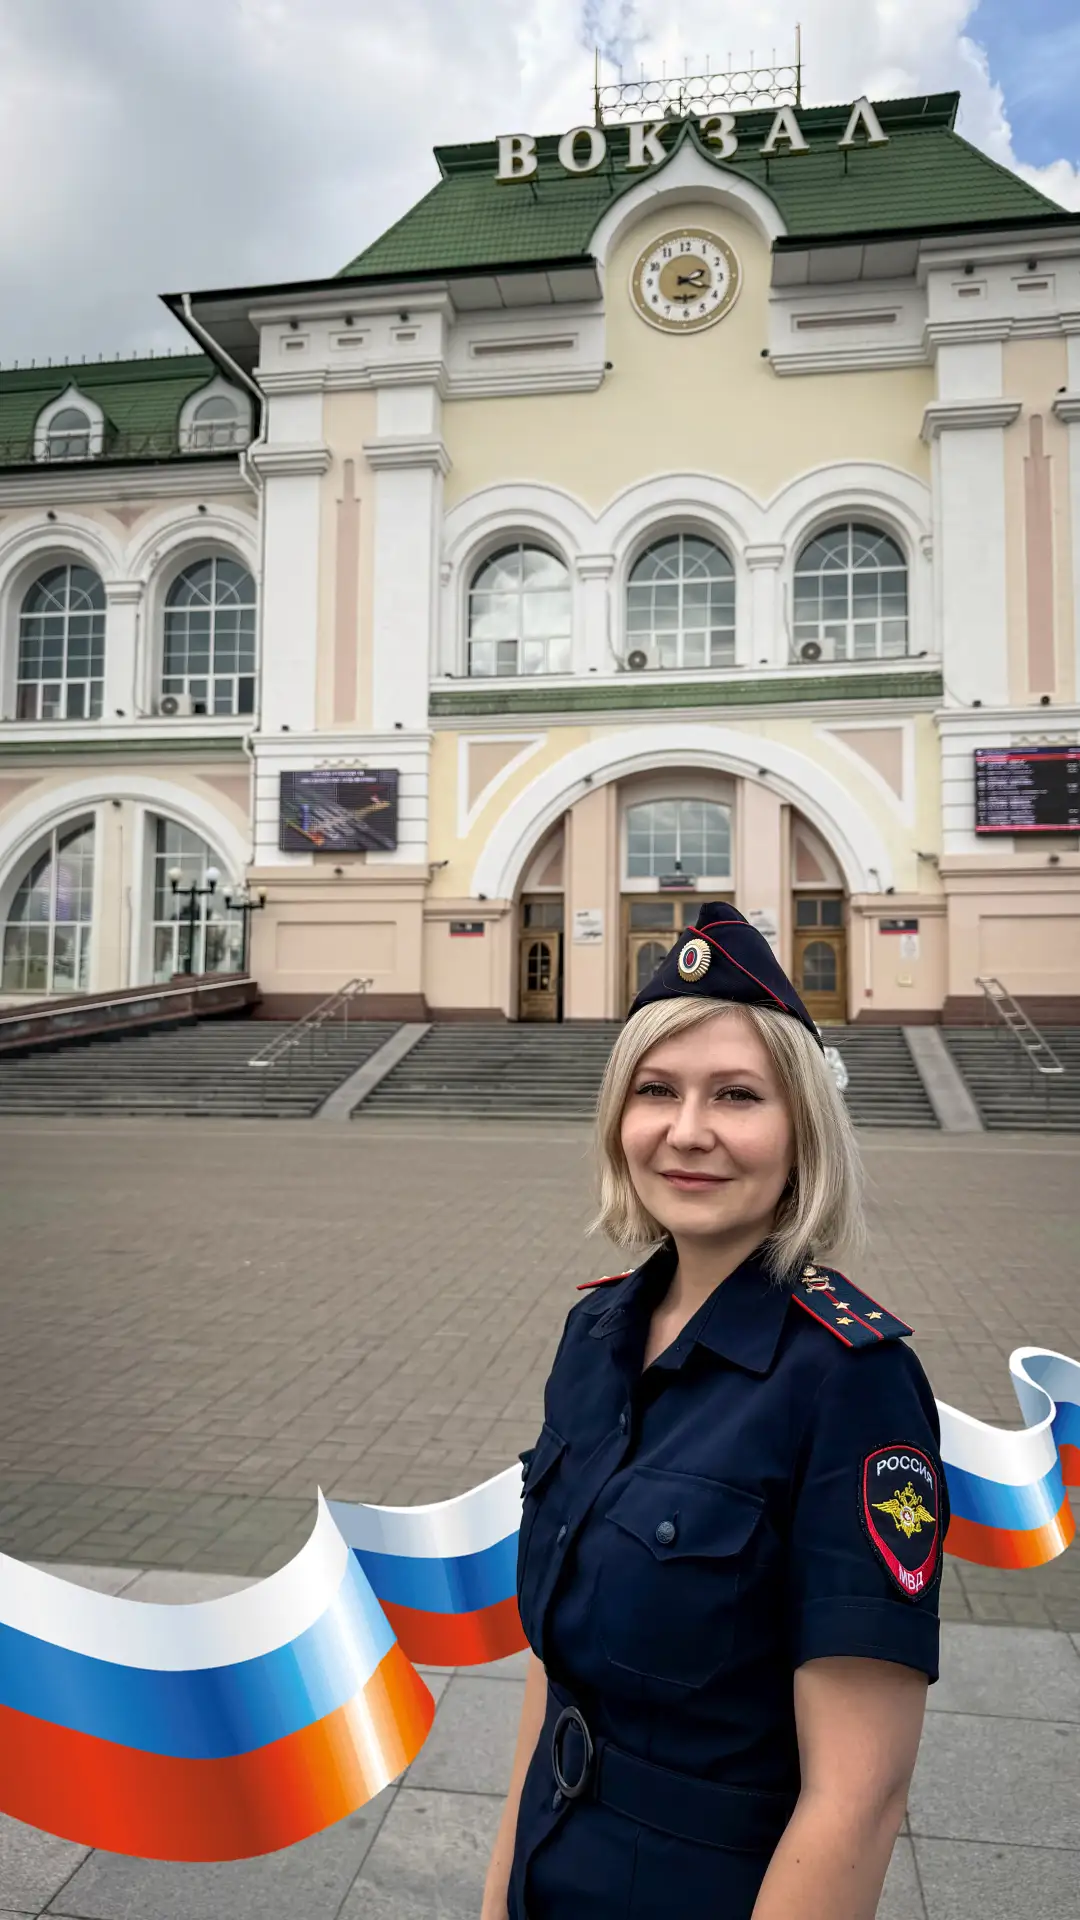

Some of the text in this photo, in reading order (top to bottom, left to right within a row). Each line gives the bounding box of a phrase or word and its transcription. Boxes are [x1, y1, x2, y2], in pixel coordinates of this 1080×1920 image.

[495, 95, 890, 184] ВОКЗАЛ
[680, 242, 691, 252] 12
[702, 244, 706, 254] 1
[662, 247, 672, 258] 11
[714, 257, 720, 266] 2
[650, 262, 660, 272] 10
[646, 278, 653, 286] 9
[718, 273, 724, 282] 3
[651, 295, 658, 303] 8
[711, 290, 718, 299] 4
[664, 305, 671, 314] 7
[699, 303, 706, 312] 5
[683, 308, 690, 317] 6
[876, 1455, 933, 1490] РОССИЯ
[899, 1565, 924, 1592] МВД
